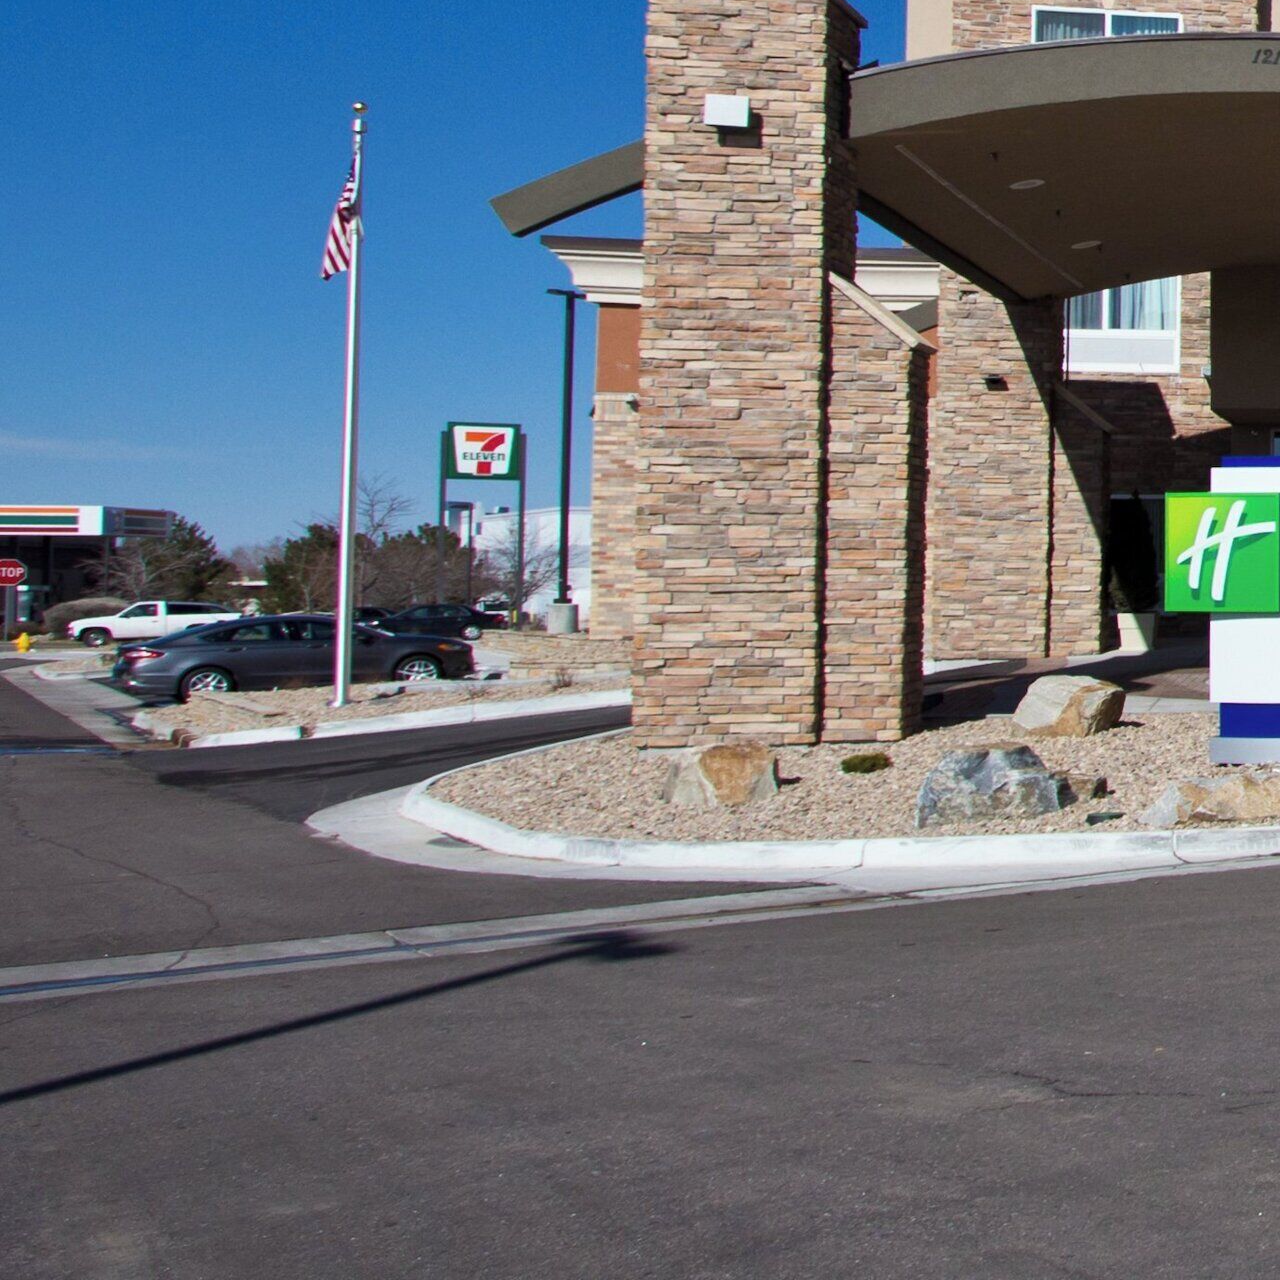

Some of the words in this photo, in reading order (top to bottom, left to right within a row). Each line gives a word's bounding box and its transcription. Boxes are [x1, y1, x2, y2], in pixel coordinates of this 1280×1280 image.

[465, 431, 506, 475] 7
[0, 567, 25, 577] TOP
[1176, 500, 1277, 601] H
